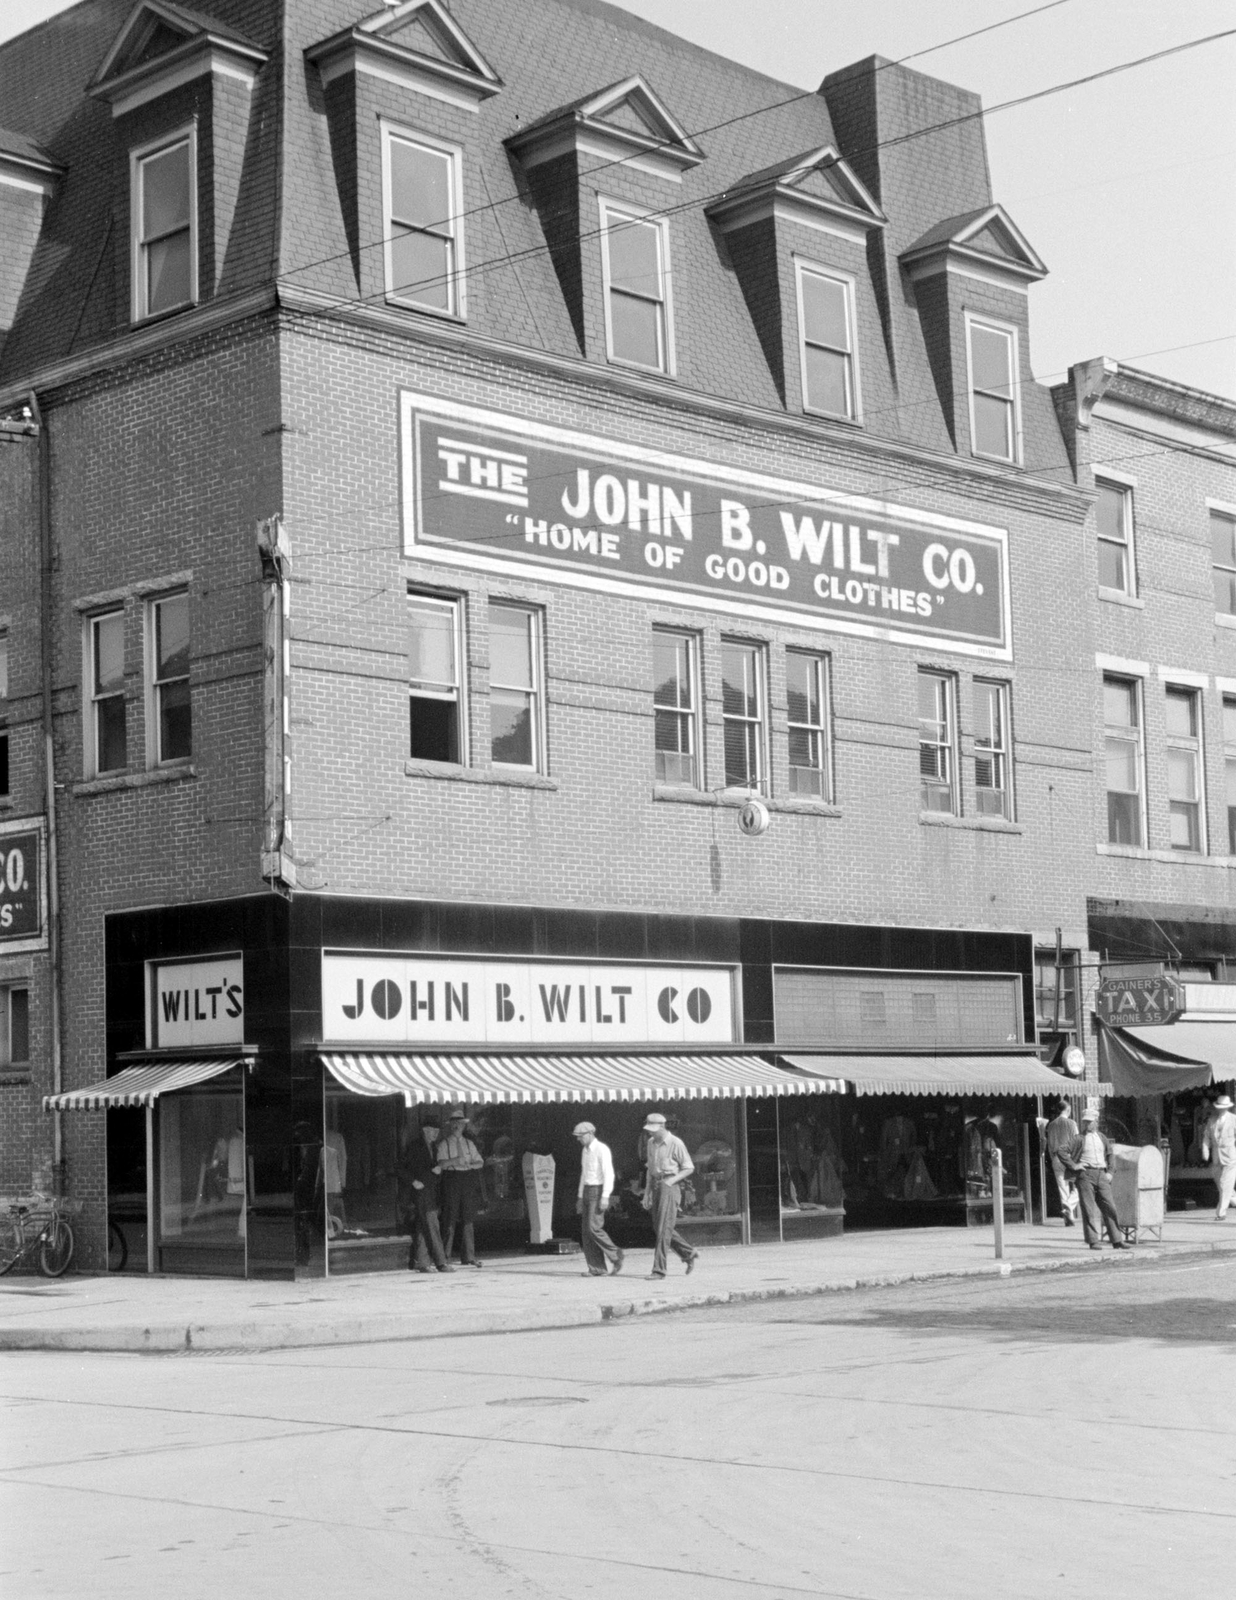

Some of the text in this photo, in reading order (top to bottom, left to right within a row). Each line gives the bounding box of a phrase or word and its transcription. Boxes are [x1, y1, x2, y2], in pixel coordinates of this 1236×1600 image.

[438, 449, 984, 596] THE JOHN B. WILT CO.
[505, 513, 945, 617] “HOME OF GOOD CLOTHES”
[162, 977, 243, 1023] WILT'S
[341, 978, 713, 1025] JOHN B. WILT CO
[1102, 988, 1170, 1014] TAXI
[1108, 978, 1162, 992] GAINER'S
[1109, 1013, 1163, 1024] PHONE 35
